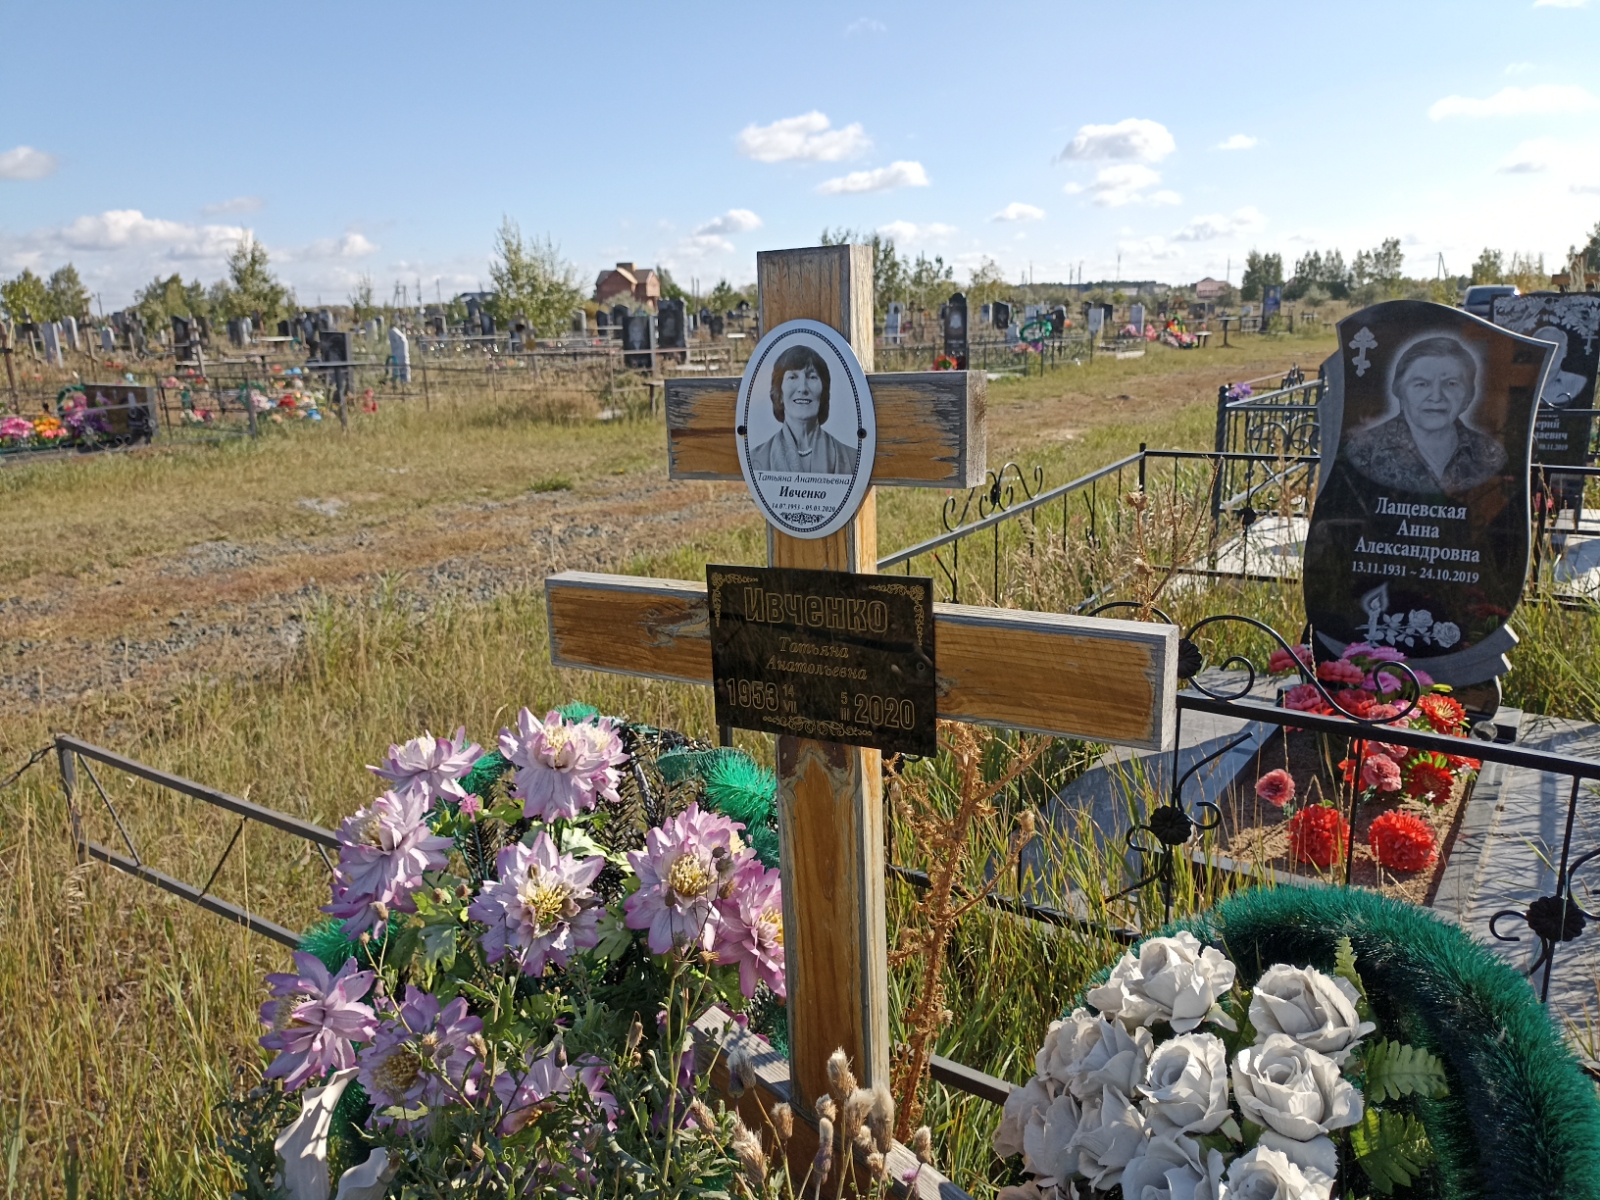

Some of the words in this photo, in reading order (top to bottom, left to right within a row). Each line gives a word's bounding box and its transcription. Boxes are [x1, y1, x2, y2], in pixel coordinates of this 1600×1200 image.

[1535, 418, 1560, 431] ерий
[758, 472, 792, 483] Татьяна
[794, 474, 850, 485] Анатольевна
[779, 485, 827, 499] Ивченко
[771, 502, 801, 511] 14.07.1953
[805, 504, 836, 513] 05.03.2020
[1375, 497, 1467, 519] Лащевская
[1396, 519, 1440, 538] Анна
[1353, 536, 1480, 564] Александровна
[1351, 561, 1406, 576] 13.11.1931
[1419, 567, 1480, 583] 24.10.2019
[743, 586, 888, 633] Ивченко
[778, 636, 849, 659] Татьяна
[765, 655, 867, 680] Анатольевна
[726, 677, 779, 711] 1953
[782, 684, 795, 697] 14
[840, 691, 848, 705] 5
[782, 699, 798, 714] VII
[840, 707, 850, 721] III
[854, 693, 915, 730] 2020
